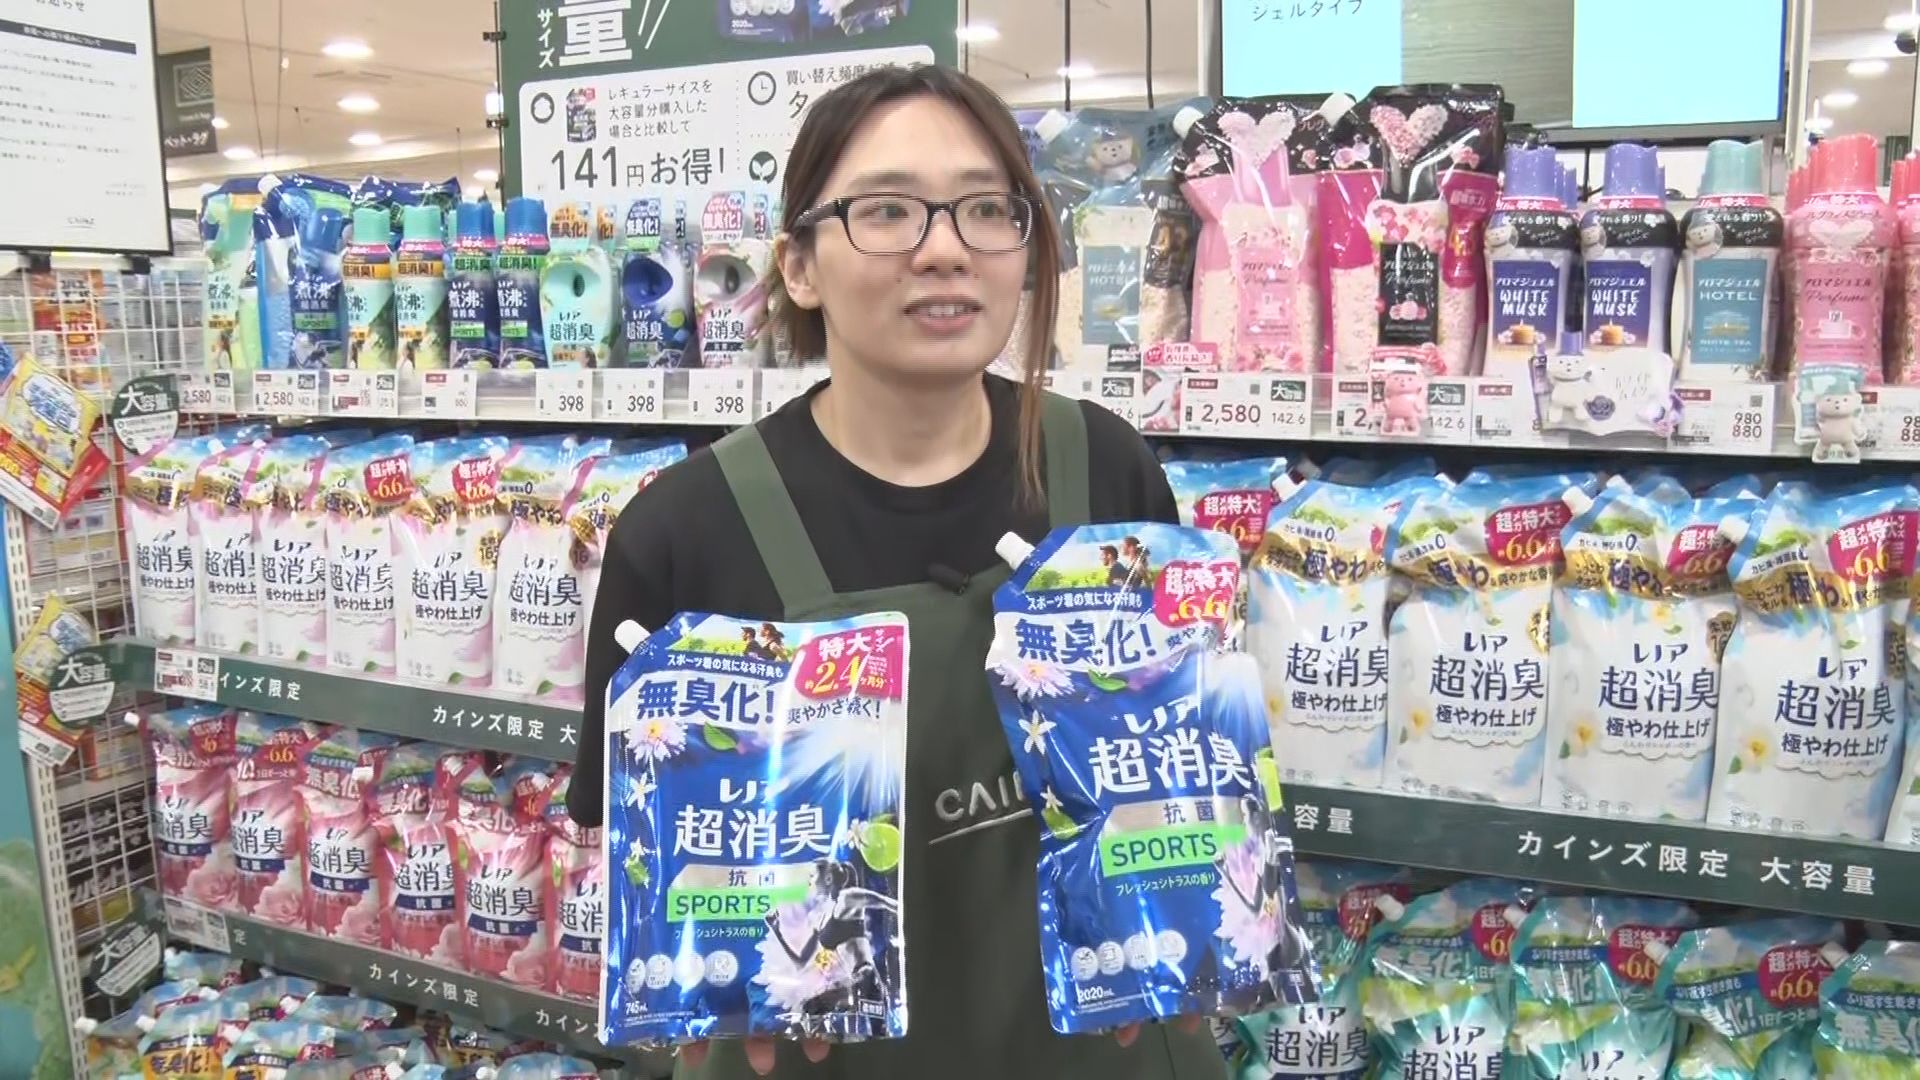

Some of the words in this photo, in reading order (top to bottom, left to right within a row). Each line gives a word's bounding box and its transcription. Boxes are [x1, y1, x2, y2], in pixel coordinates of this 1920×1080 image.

[537, 8, 554, 68] サイズ
[608, 79, 713, 100] レギュラーサイズを
[608, 99, 708, 120] 大容量分購入した
[608, 119, 691, 138] 場合と比較して
[1499, 289, 1550, 303] WHITE
[1590, 289, 1640, 304] WHITE
[1699, 290, 1757, 302] HOTEL
[1501, 302, 1548, 318] MUSK
[1592, 302, 1638, 318] MUSK
[550, 321, 597, 342] 超消臭
[626, 321, 664, 341] 超消臭
[703, 321, 746, 341] 超消臭
[264, 391, 294, 406] 2,580
[559, 395, 585, 412] 398
[627, 396, 655, 413] 398
[714, 397, 744, 414] 398
[1200, 403, 1262, 424] 2,580
[1734, 413, 1762, 425] 980
[1732, 425, 1762, 438] 880
[137, 542, 194, 573] 超消臭
[205, 549, 255, 578] 超消
[261, 554, 326, 586] 超消臭
[208, 580, 256, 595] 極やわ仕上
[412, 569, 489, 602] 超消臭
[508, 570, 583, 607] 超消臭
[415, 604, 484, 621] 極やわ仕上げ
[510, 609, 577, 627] 極やわ仕上げ
[819, 635, 872, 660] 特大
[1014, 617, 1158, 667] 無臭化!
[58, 656, 112, 689] 大容量
[666, 653, 785, 679] スポーツ着の気になる汗臭も
[1285, 643, 1388, 688] 超消臭
[1429, 654, 1545, 702] 超消臭
[636, 677, 776, 725] 無臭化!
[1290, 690, 1387, 714] 極やわ仕上げ
[1599, 665, 1719, 713] 超消臭
[787, 698, 883, 725] 爽やかさ続く!
[1435, 703, 1538, 728] 極やわ仕上げ
[1774, 679, 1896, 731] 超消臭
[432, 703, 546, 742] カインズ限定
[1605, 715, 1712, 741] 極やわ仕上げ
[1781, 732, 1889, 758] 極やわ仕上げ
[1087, 727, 1252, 797] 超消臭
[1163, 798, 1216, 825] 抗菌
[673, 802, 832, 860] 超消臭
[1110, 831, 1218, 867] SPORTS
[1517, 829, 1729, 879] カインズ限定
[1759, 855, 1876, 897] 大容量
[727, 869, 776, 888] 抗菌
[1114, 872, 1216, 898] フレッシュシトラスの香り
[466, 880, 541, 917] 超消臭
[675, 893, 772, 917] SPORTS
[368, 962, 481, 1009] カインズ限定
[1265, 1027, 1370, 1069] 超消臭
